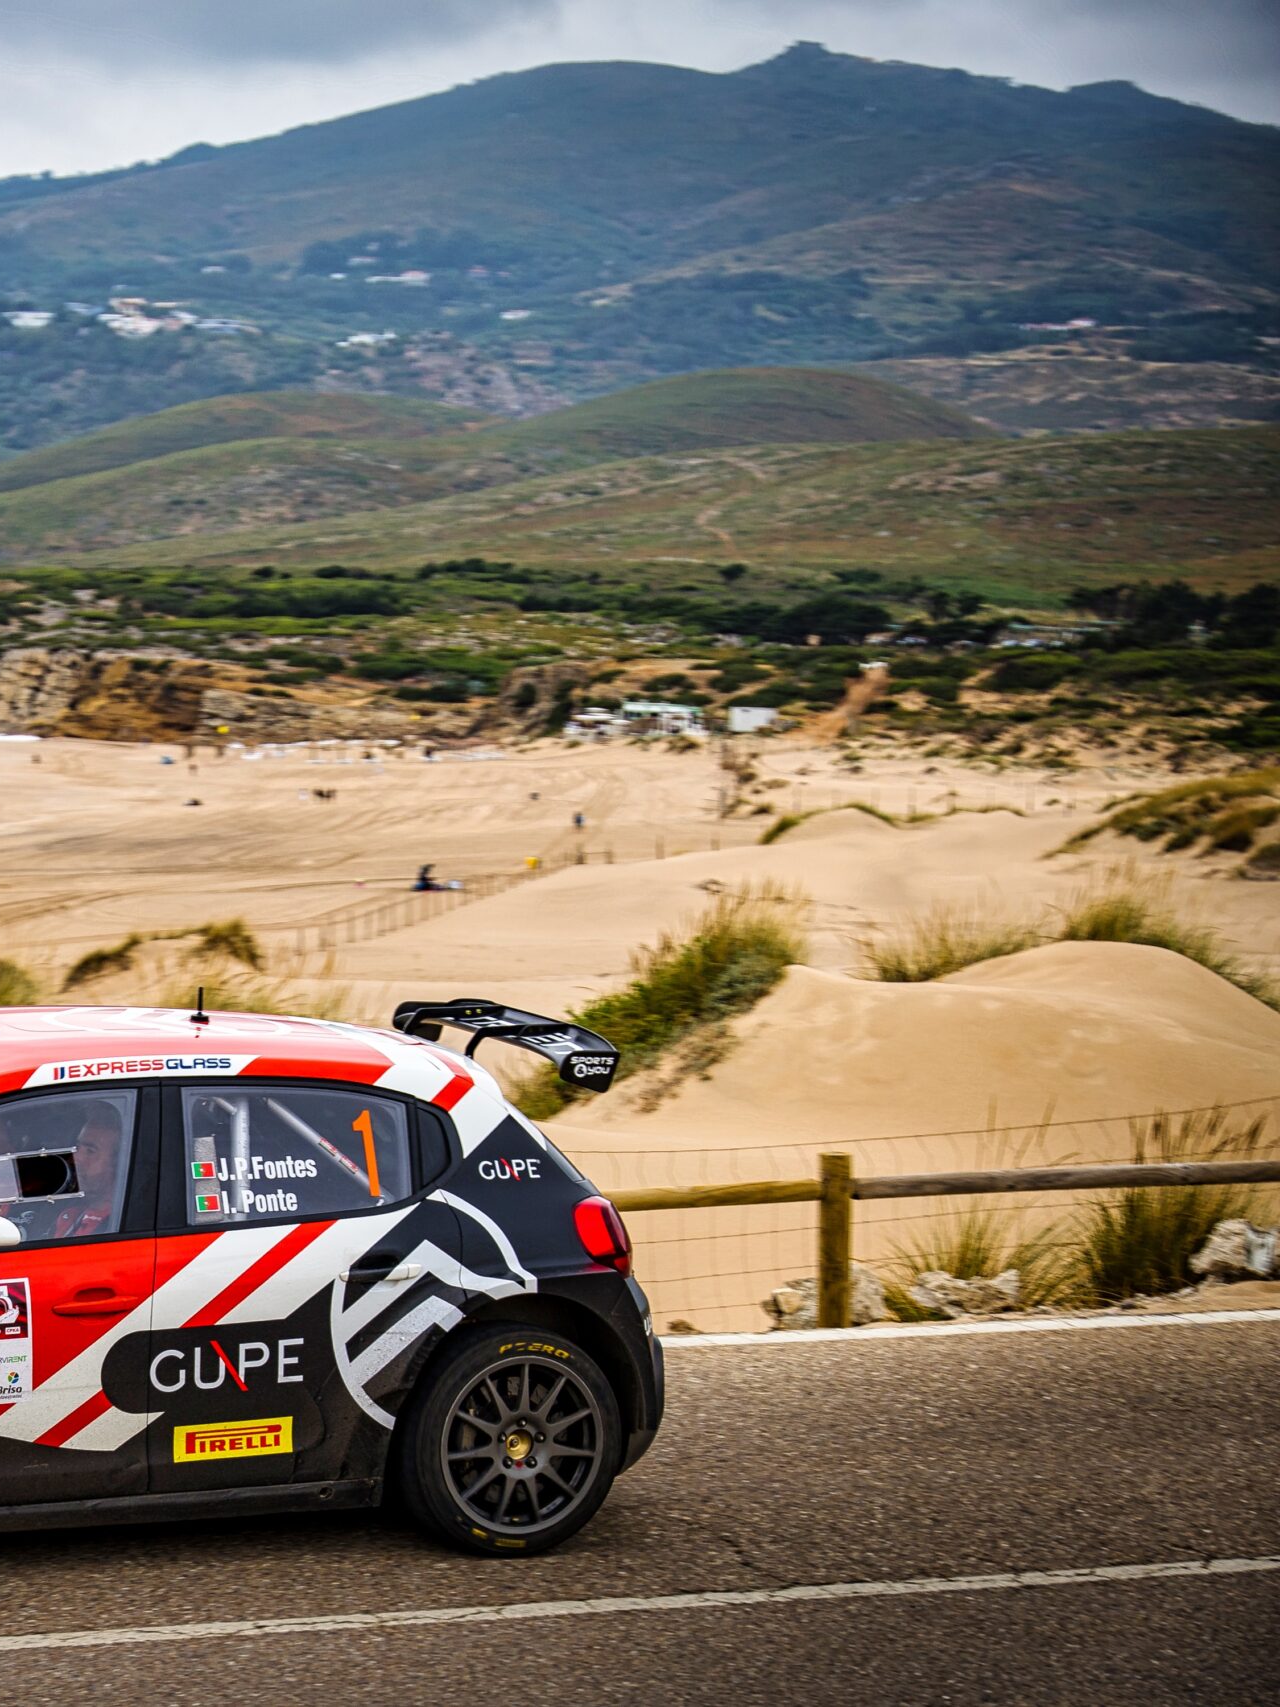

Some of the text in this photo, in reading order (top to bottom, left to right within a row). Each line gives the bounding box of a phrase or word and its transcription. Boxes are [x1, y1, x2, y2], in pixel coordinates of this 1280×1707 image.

[570, 1056, 615, 1065] SPORTS
[352, 1109, 380, 1197] 1
[241, 1189, 298, 1213] Ponte
[186, 1424, 282, 1454] PIRELLI
